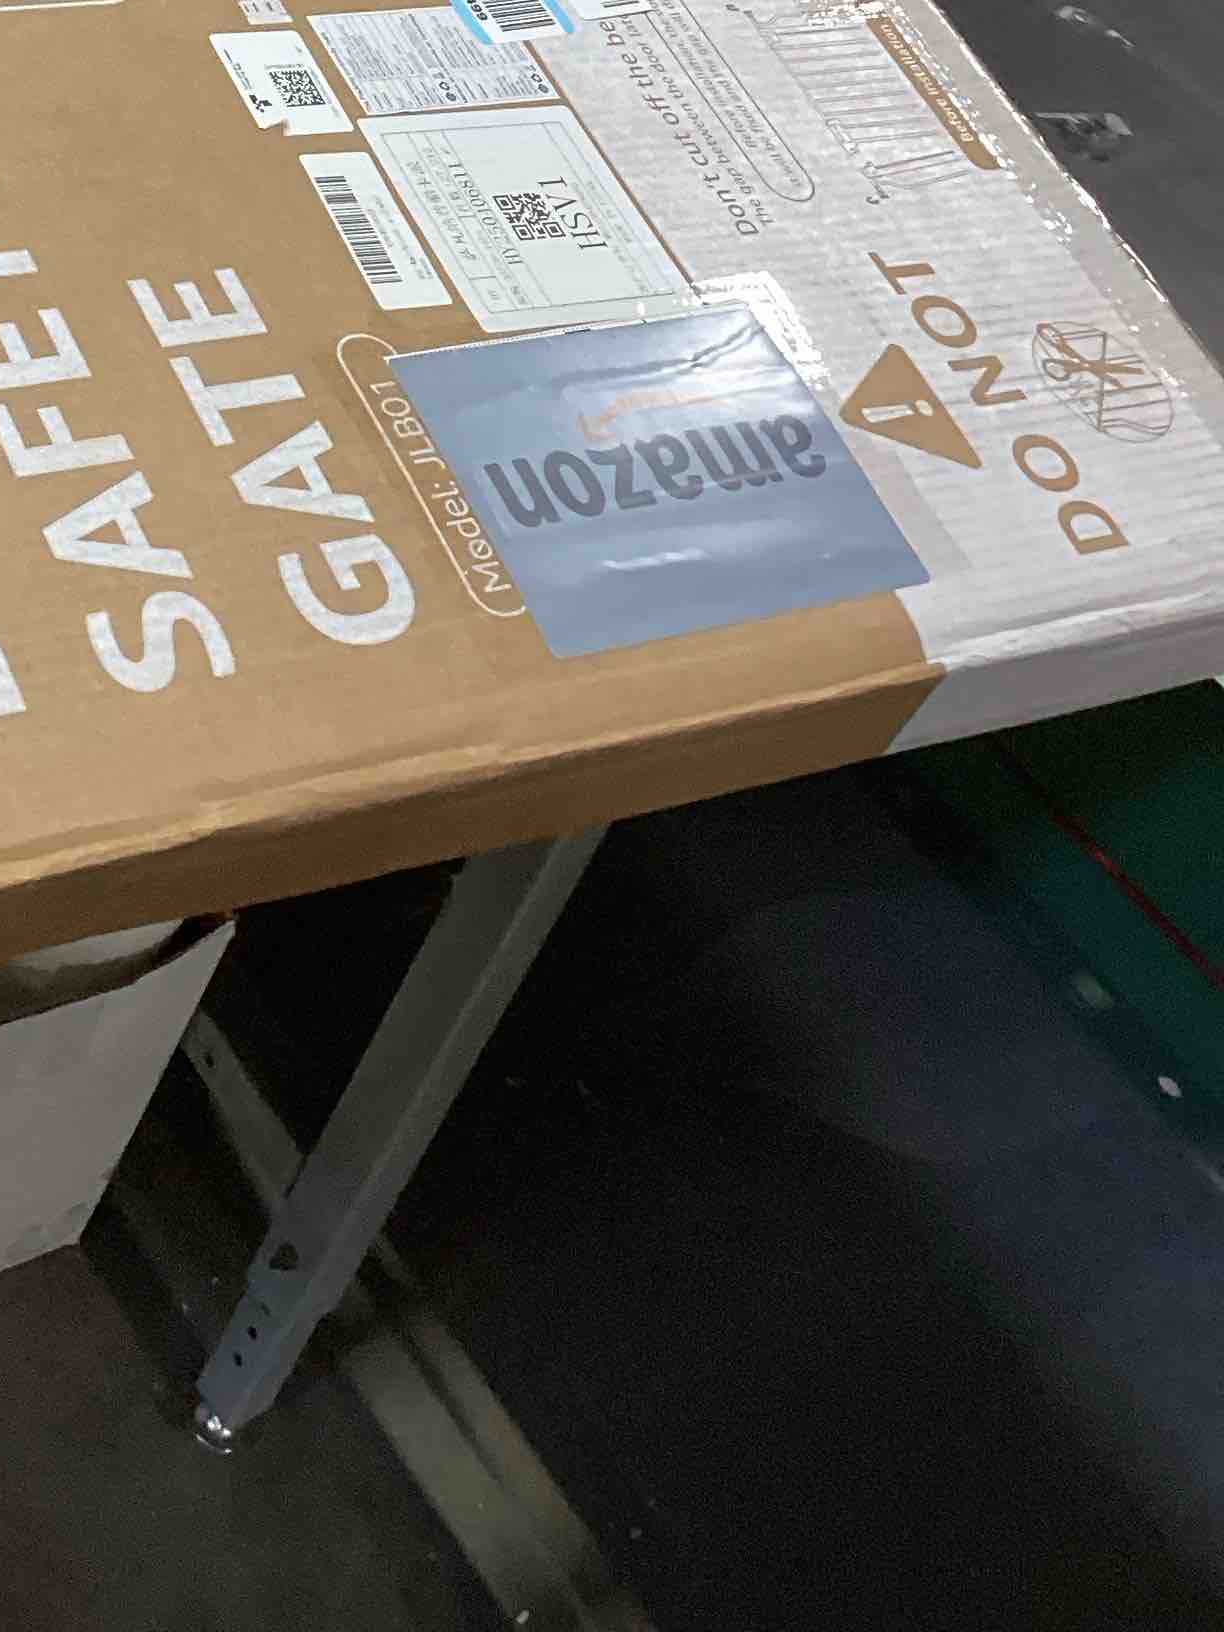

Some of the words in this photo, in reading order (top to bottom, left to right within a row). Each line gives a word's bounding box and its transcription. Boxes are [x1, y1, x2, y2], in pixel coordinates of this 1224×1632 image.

[616, 50, 656, 89] the
[642, 92, 683, 128] off
[671, 129, 711, 168] cut
[532, 174, 609, 250] HSV1
[868, 251, 1026, 406] NOT
[126, 265, 417, 648] GATE
[369, 380, 447, 470] JLB01
[483, 414, 827, 528] amazon
[431, 480, 513, 593] Model:
[1013, 434, 1128, 555] DO
